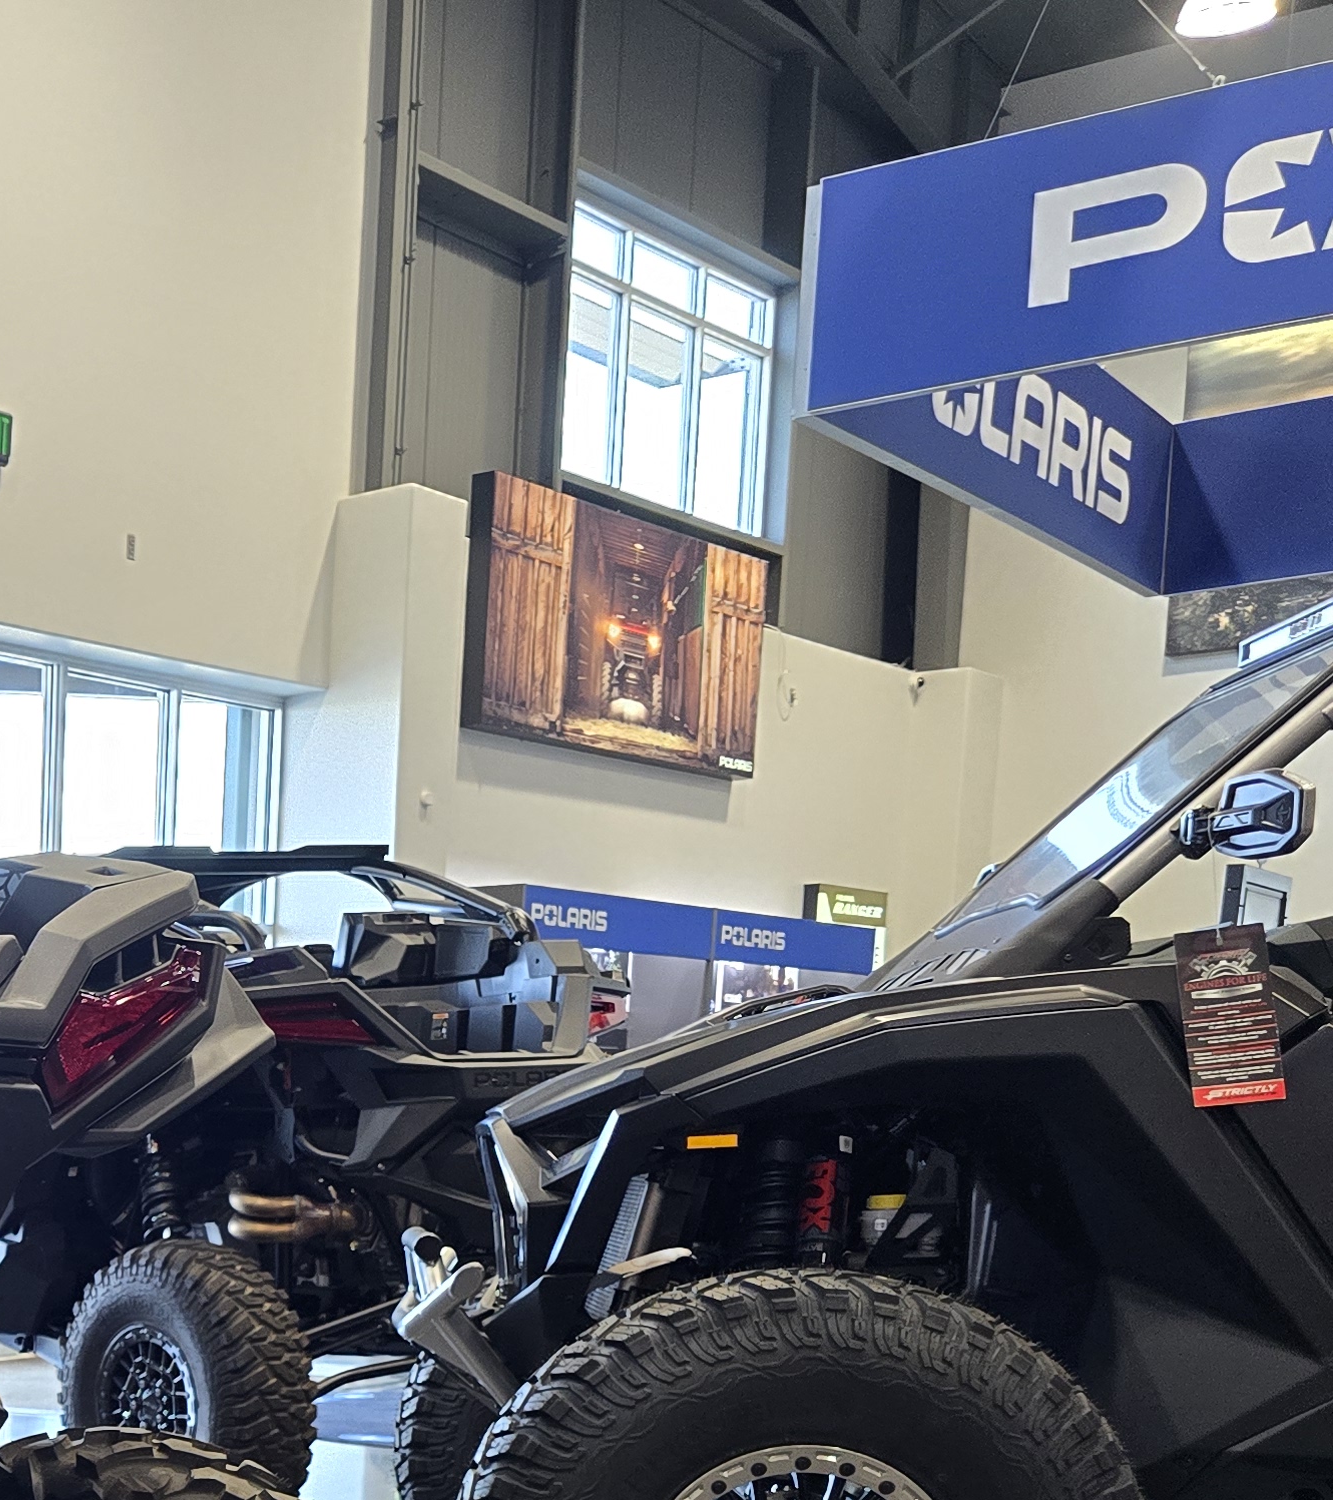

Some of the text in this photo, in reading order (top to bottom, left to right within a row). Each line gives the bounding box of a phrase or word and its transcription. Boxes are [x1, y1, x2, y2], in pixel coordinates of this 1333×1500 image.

[531, 902, 608, 932] POLARIS
[720, 925, 786, 951] POLARIS
[1183, 973, 1268, 991] ENGINES FOR LIFE
[1203, 1084, 1278, 1101] STRICTLY
[799, 1159, 837, 1233] FOX
